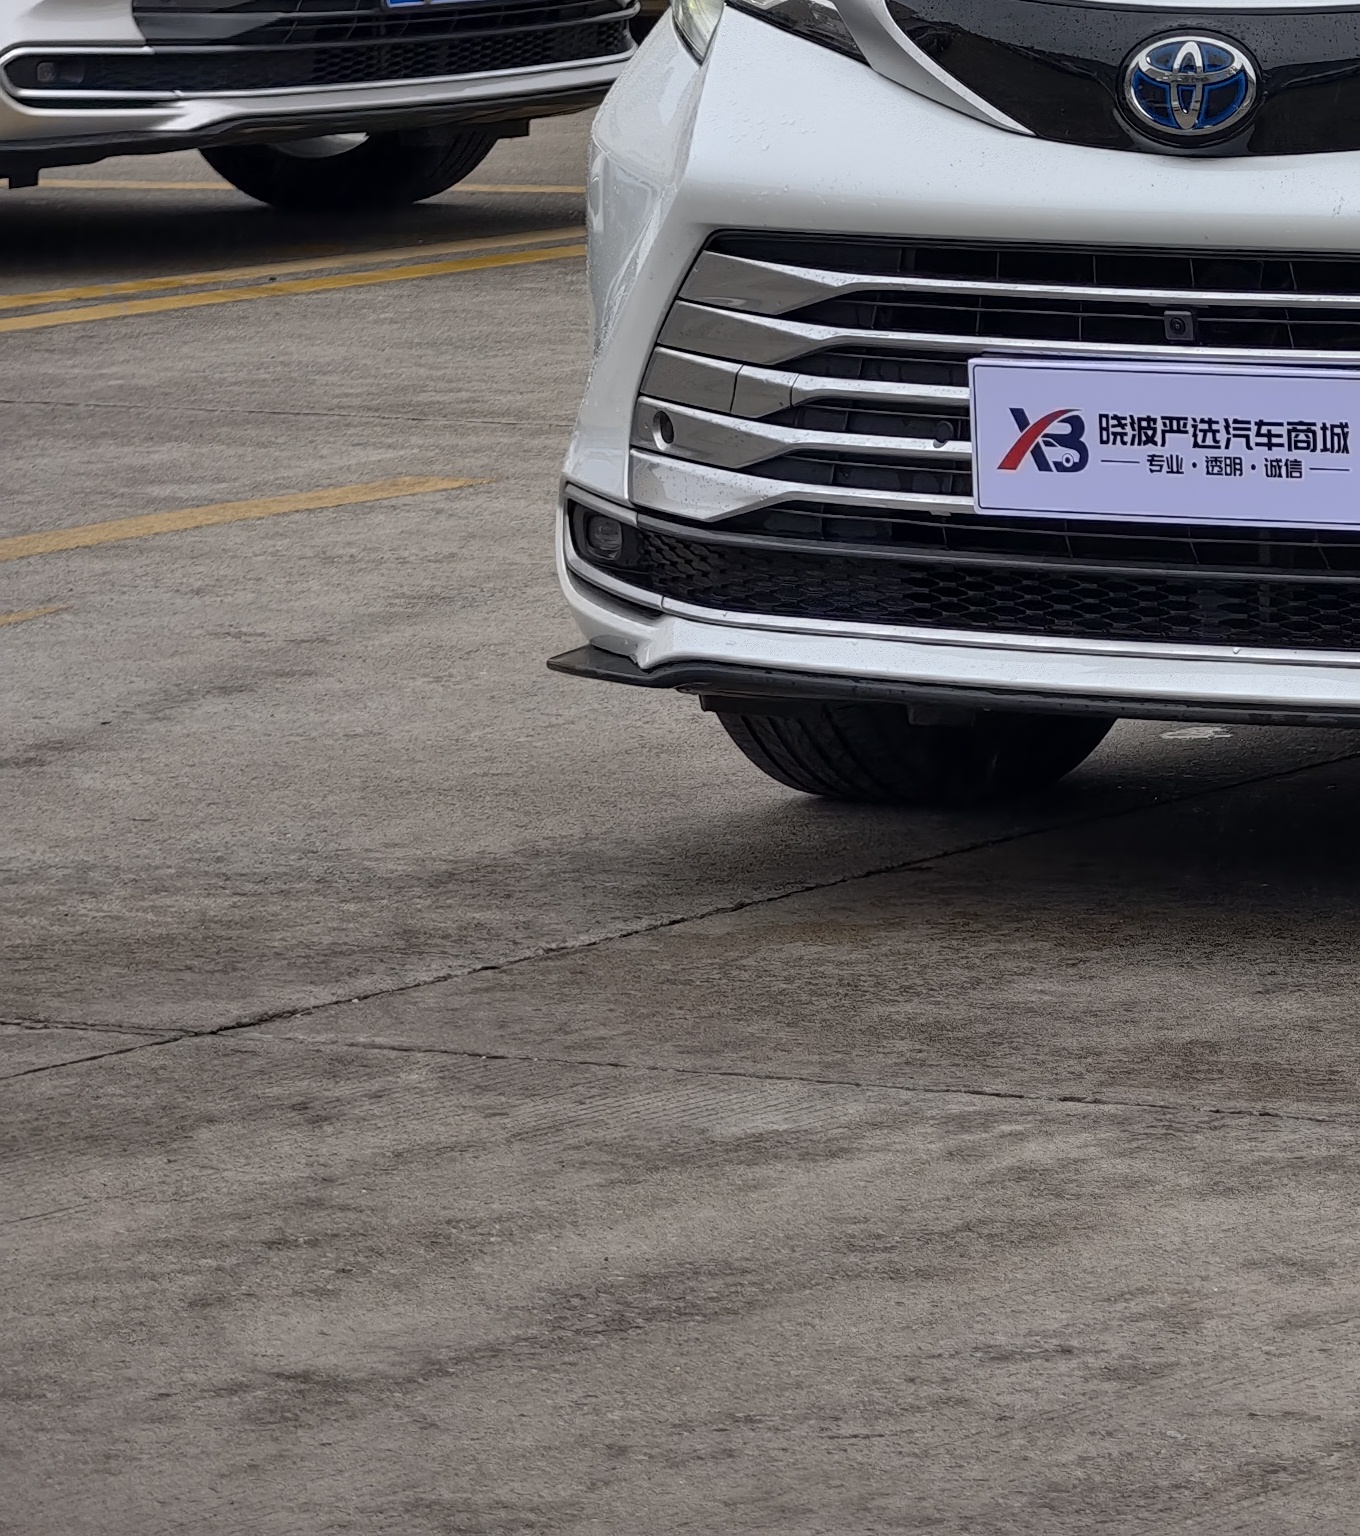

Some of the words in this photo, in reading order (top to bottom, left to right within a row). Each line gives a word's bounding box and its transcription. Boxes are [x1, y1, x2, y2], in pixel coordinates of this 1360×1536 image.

[1098, 412, 1351, 455] 晓波严选汽车商城
